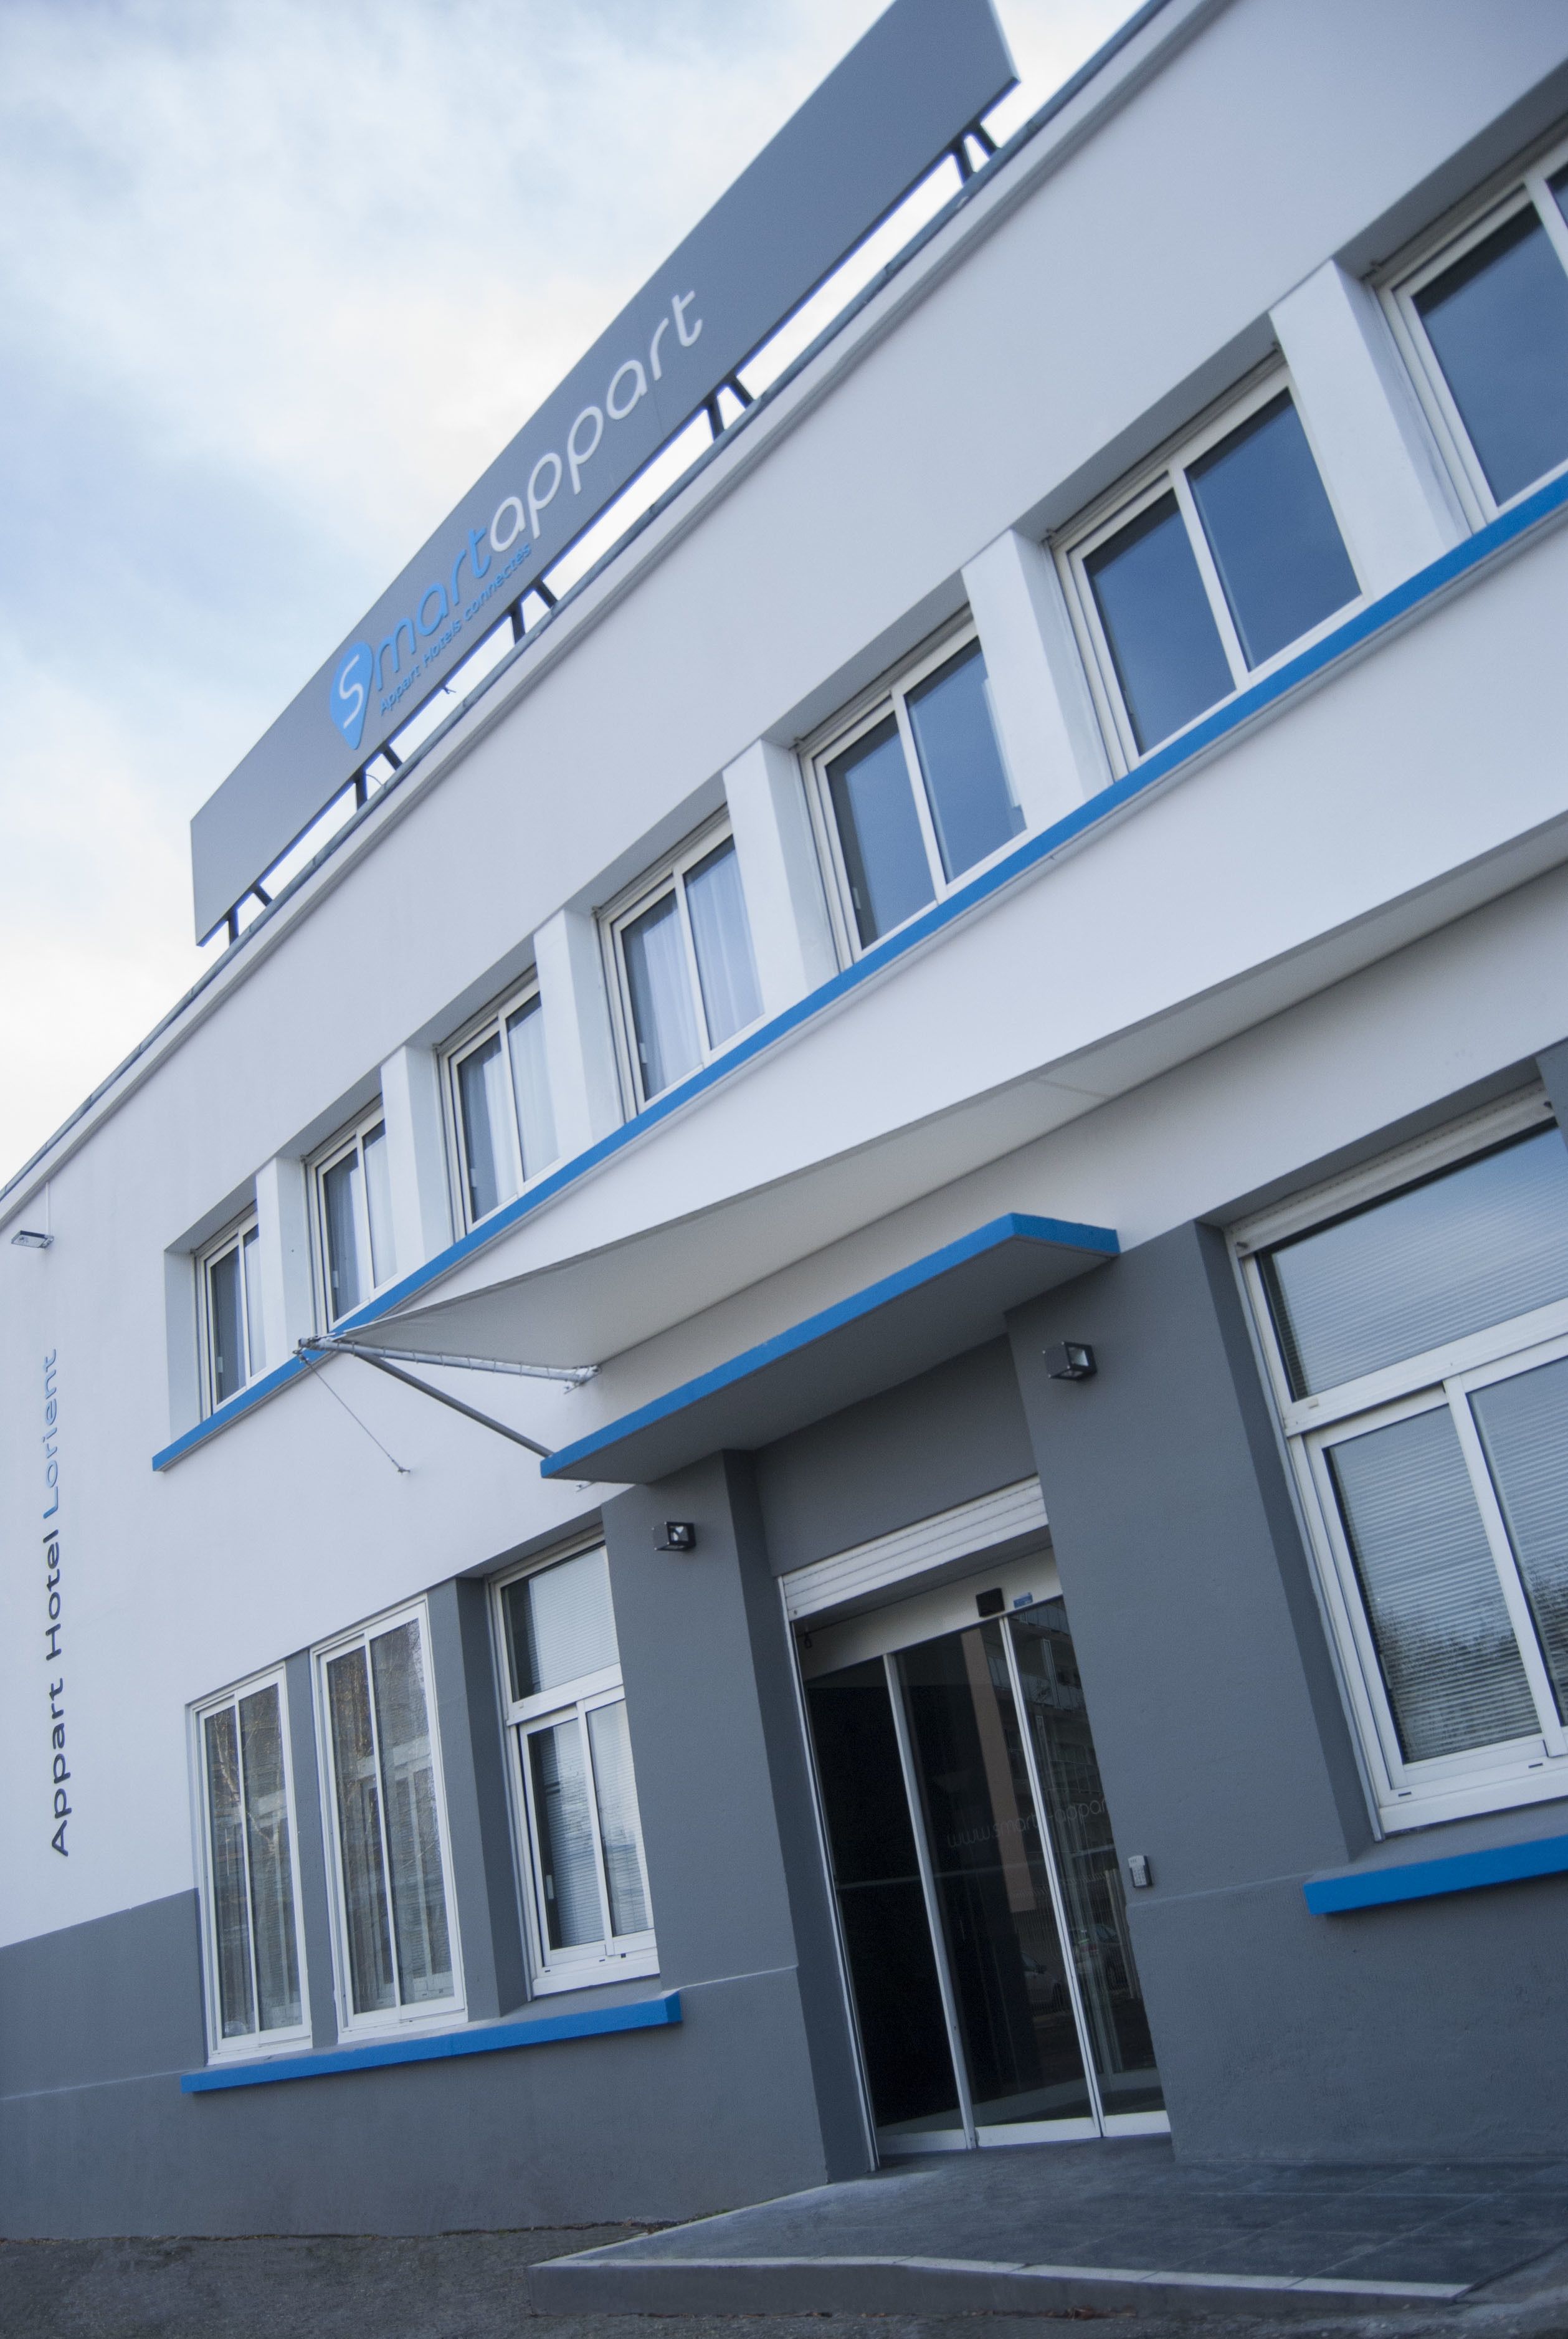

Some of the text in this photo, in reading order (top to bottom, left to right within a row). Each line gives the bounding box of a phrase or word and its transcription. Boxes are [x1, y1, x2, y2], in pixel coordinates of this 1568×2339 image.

[381, 665, 421, 715] Appart
[424, 619, 462, 668] Hotels
[43, 1348, 72, 1857] Appart Hotel Lorient
